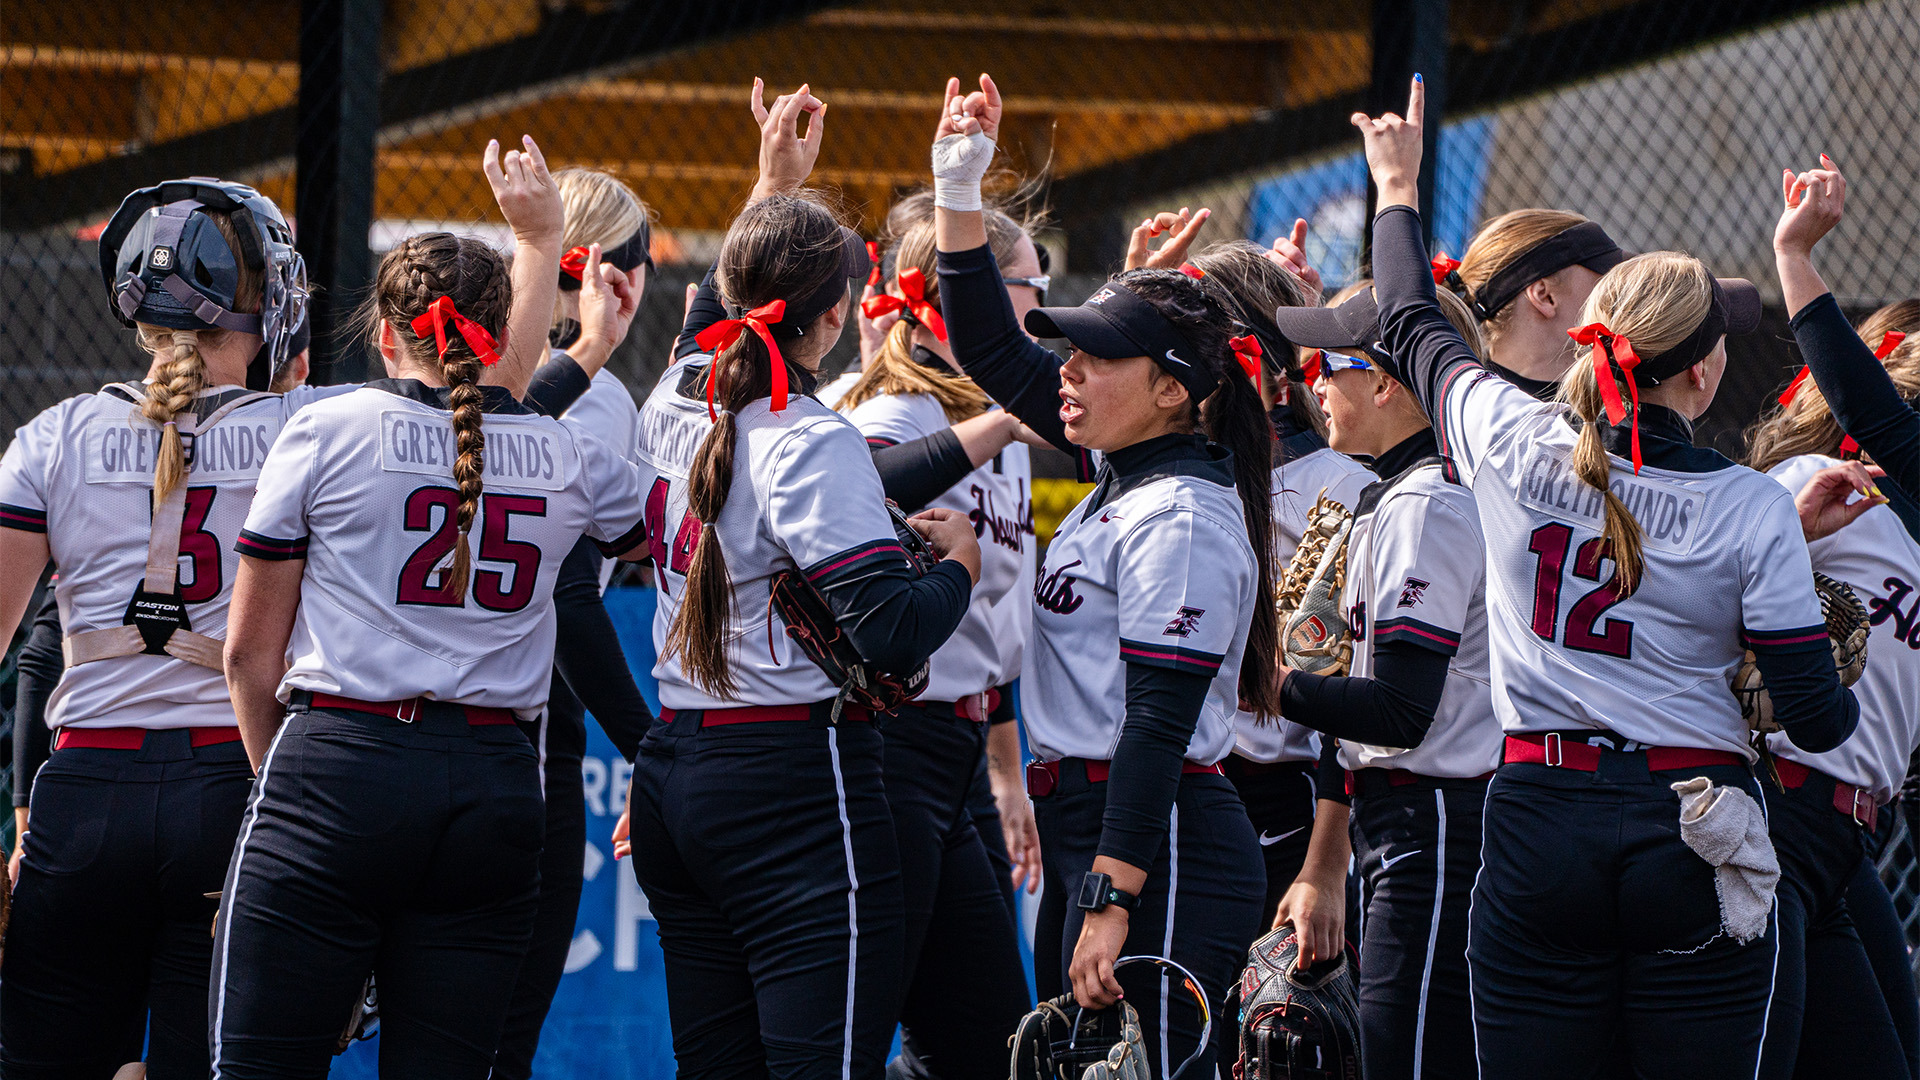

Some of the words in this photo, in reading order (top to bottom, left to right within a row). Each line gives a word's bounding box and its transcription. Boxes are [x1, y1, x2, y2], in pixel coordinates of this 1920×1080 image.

[391, 419, 555, 481] GREYUNDS
[396, 485, 547, 613] 25
[645, 475, 704, 596] 44
[1528, 521, 1643, 660] 12
[135, 601, 180, 611] EASTON
